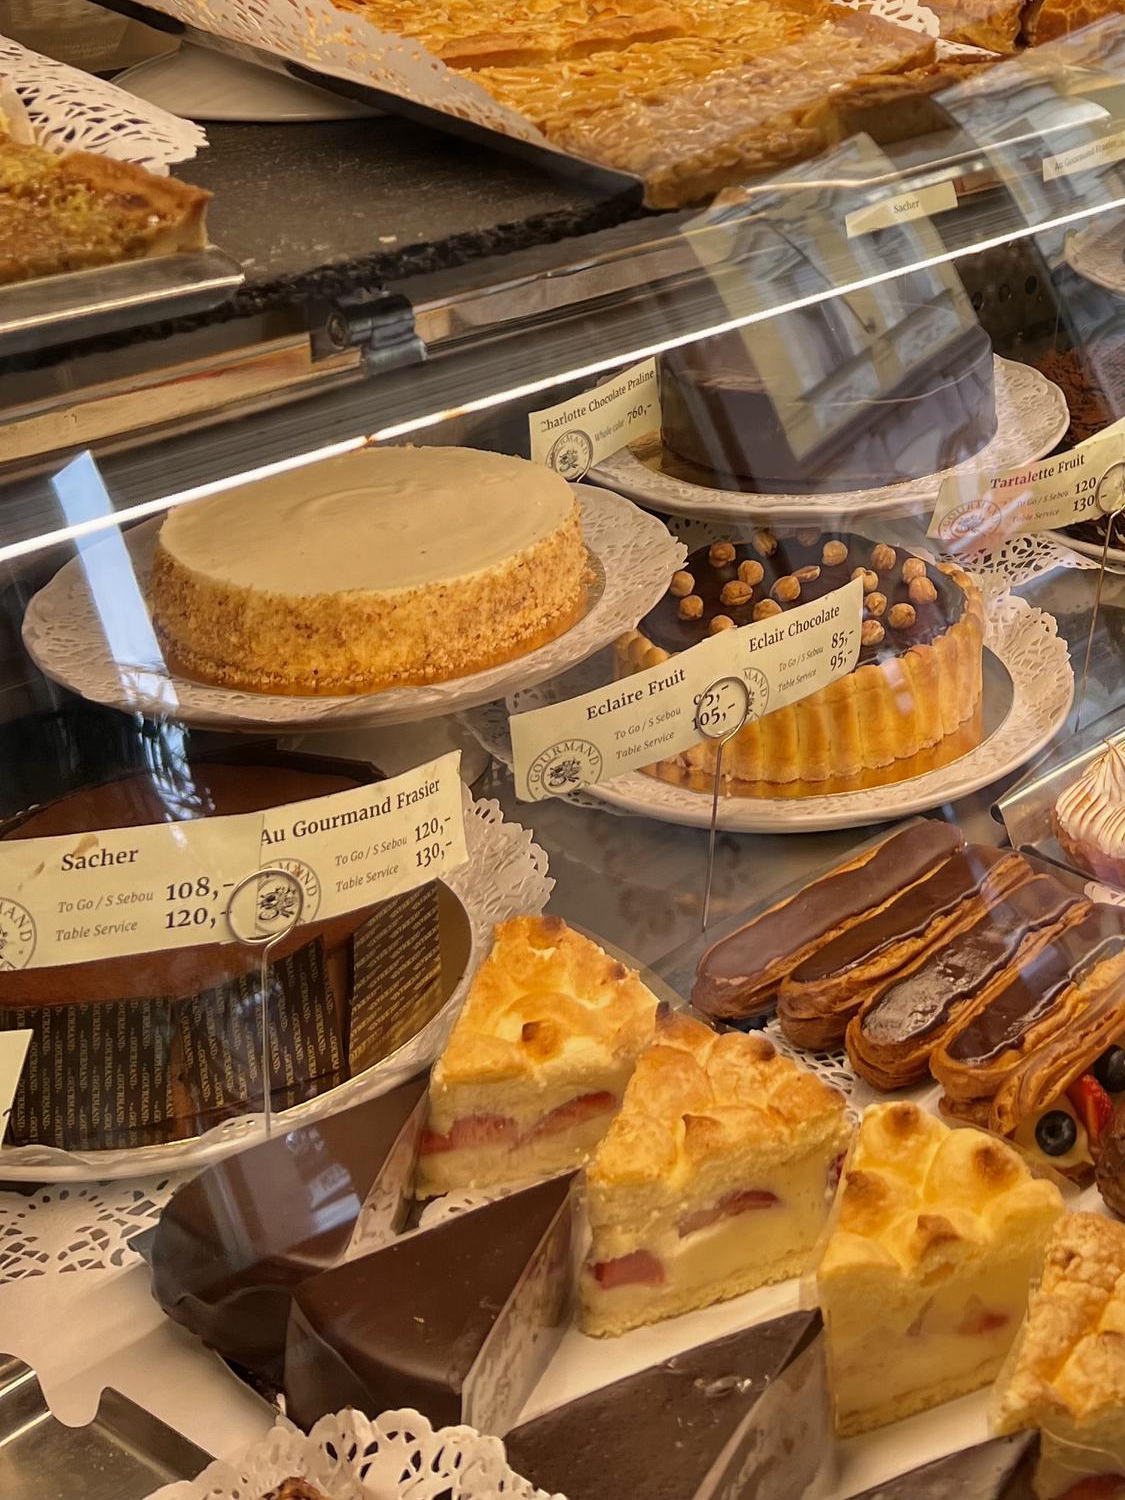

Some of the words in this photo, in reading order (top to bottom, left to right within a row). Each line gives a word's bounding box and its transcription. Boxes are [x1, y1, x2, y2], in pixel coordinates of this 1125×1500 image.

[893, 198, 921, 215] Sacher
[539, 404, 587, 433] Charlotte
[587, 384, 627, 413] Chocolate
[626, 369, 655, 392] Praline
[626, 402, 653, 426] 760,-
[990, 466, 1055, 490] Tartalette
[1056, 453, 1086, 475] Fruit
[1034, 508, 1060, 520] Service
[748, 624, 785, 654] Eclair
[787, 604, 841, 638] Chocolate
[777, 677, 797, 694] Table
[796, 667, 818, 686] Service
[829, 648, 855, 672] 95,-
[778, 659, 787, 672] To
[787, 656, 798, 669] Go
[801, 651, 806, 663] S
[806, 644, 824, 661] Sebou
[830, 629, 856, 650] 85,-
[585, 686, 644, 722] Eclaire
[646, 667, 687, 697] Fruit
[614, 728, 626, 741] To
[626, 723, 641, 738] Go
[641, 720, 648, 734] /
[648, 717, 655, 730] S
[655, 705, 682, 727] Sebou
[529, 740, 601, 784] GOURMAND
[615, 741, 642, 761] Table
[642, 729, 675, 751] Service
[260, 826, 286, 847] Au
[291, 799, 393, 839] Gourmand
[396, 777, 441, 810] Frasier
[59, 846, 140, 873] Sacher
[334, 851, 350, 867] To
[350, 848, 365, 864] Go
[366, 846, 372, 861] /
[372, 843, 380, 856] S
[379, 834, 408, 854] Sebou
[413, 815, 452, 843] 120,-
[335, 877, 365, 893] Table
[364, 862, 400, 886] Service
[414, 840, 454, 868] 130,-
[57, 900, 74, 914] To
[76, 898, 95, 913] Go
[96, 896, 104, 912] /
[104, 894, 113, 907] S
[113, 888, 155, 907] Sebou
[164, 875, 237, 902] 108,-
[55, 926, 92, 943] Table
[94, 919, 138, 938] Service
[164, 906, 233, 930] 120,-
